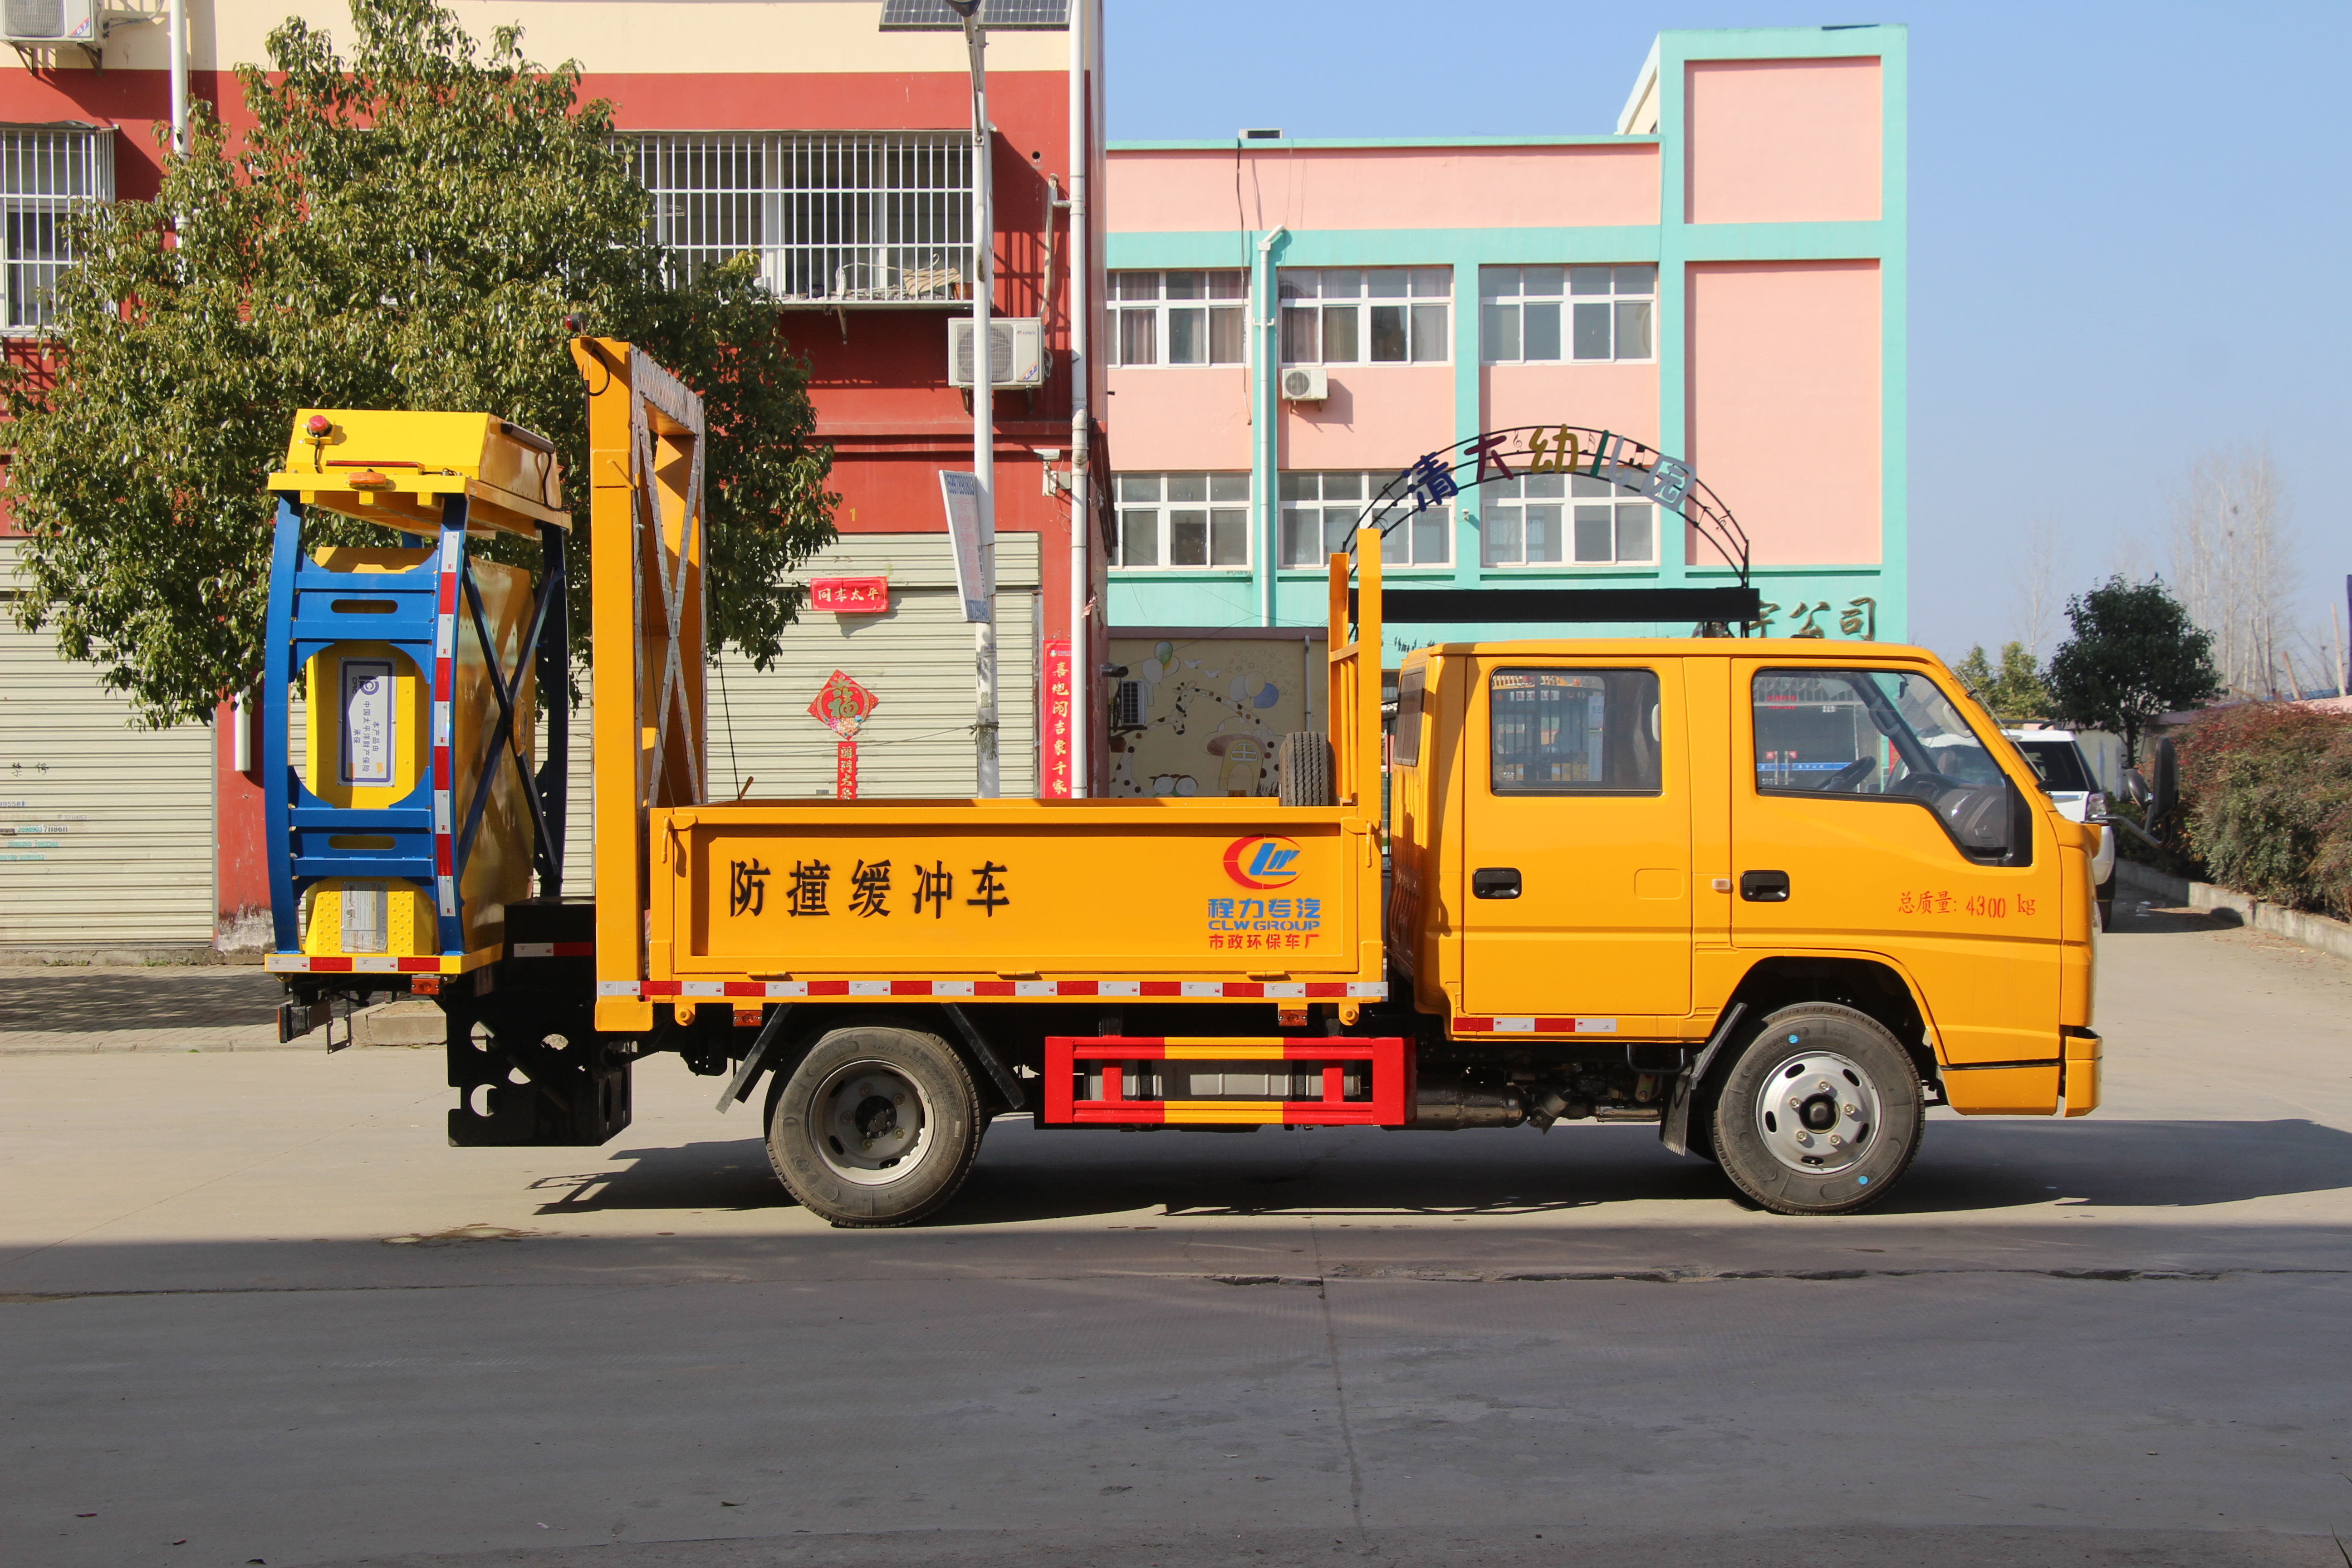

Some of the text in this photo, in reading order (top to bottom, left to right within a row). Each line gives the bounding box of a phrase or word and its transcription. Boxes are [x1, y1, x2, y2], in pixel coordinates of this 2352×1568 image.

[1402, 424, 1696, 512] 清大幼儿园
[828, 686, 859, 718] 福
[353, 728, 361, 744] 承保
[362, 701, 371, 772] 中国太平洋财产保险
[730, 858, 1010, 919] 防撞缓冲车
[1208, 898, 1320, 918] 程力专汽
[1966, 895, 2006, 919] 4300
[2017, 893, 2036, 916] kg
[1208, 921, 1320, 931] CLW GROUP
[1209, 934, 1319, 950] 市政环保车厂
